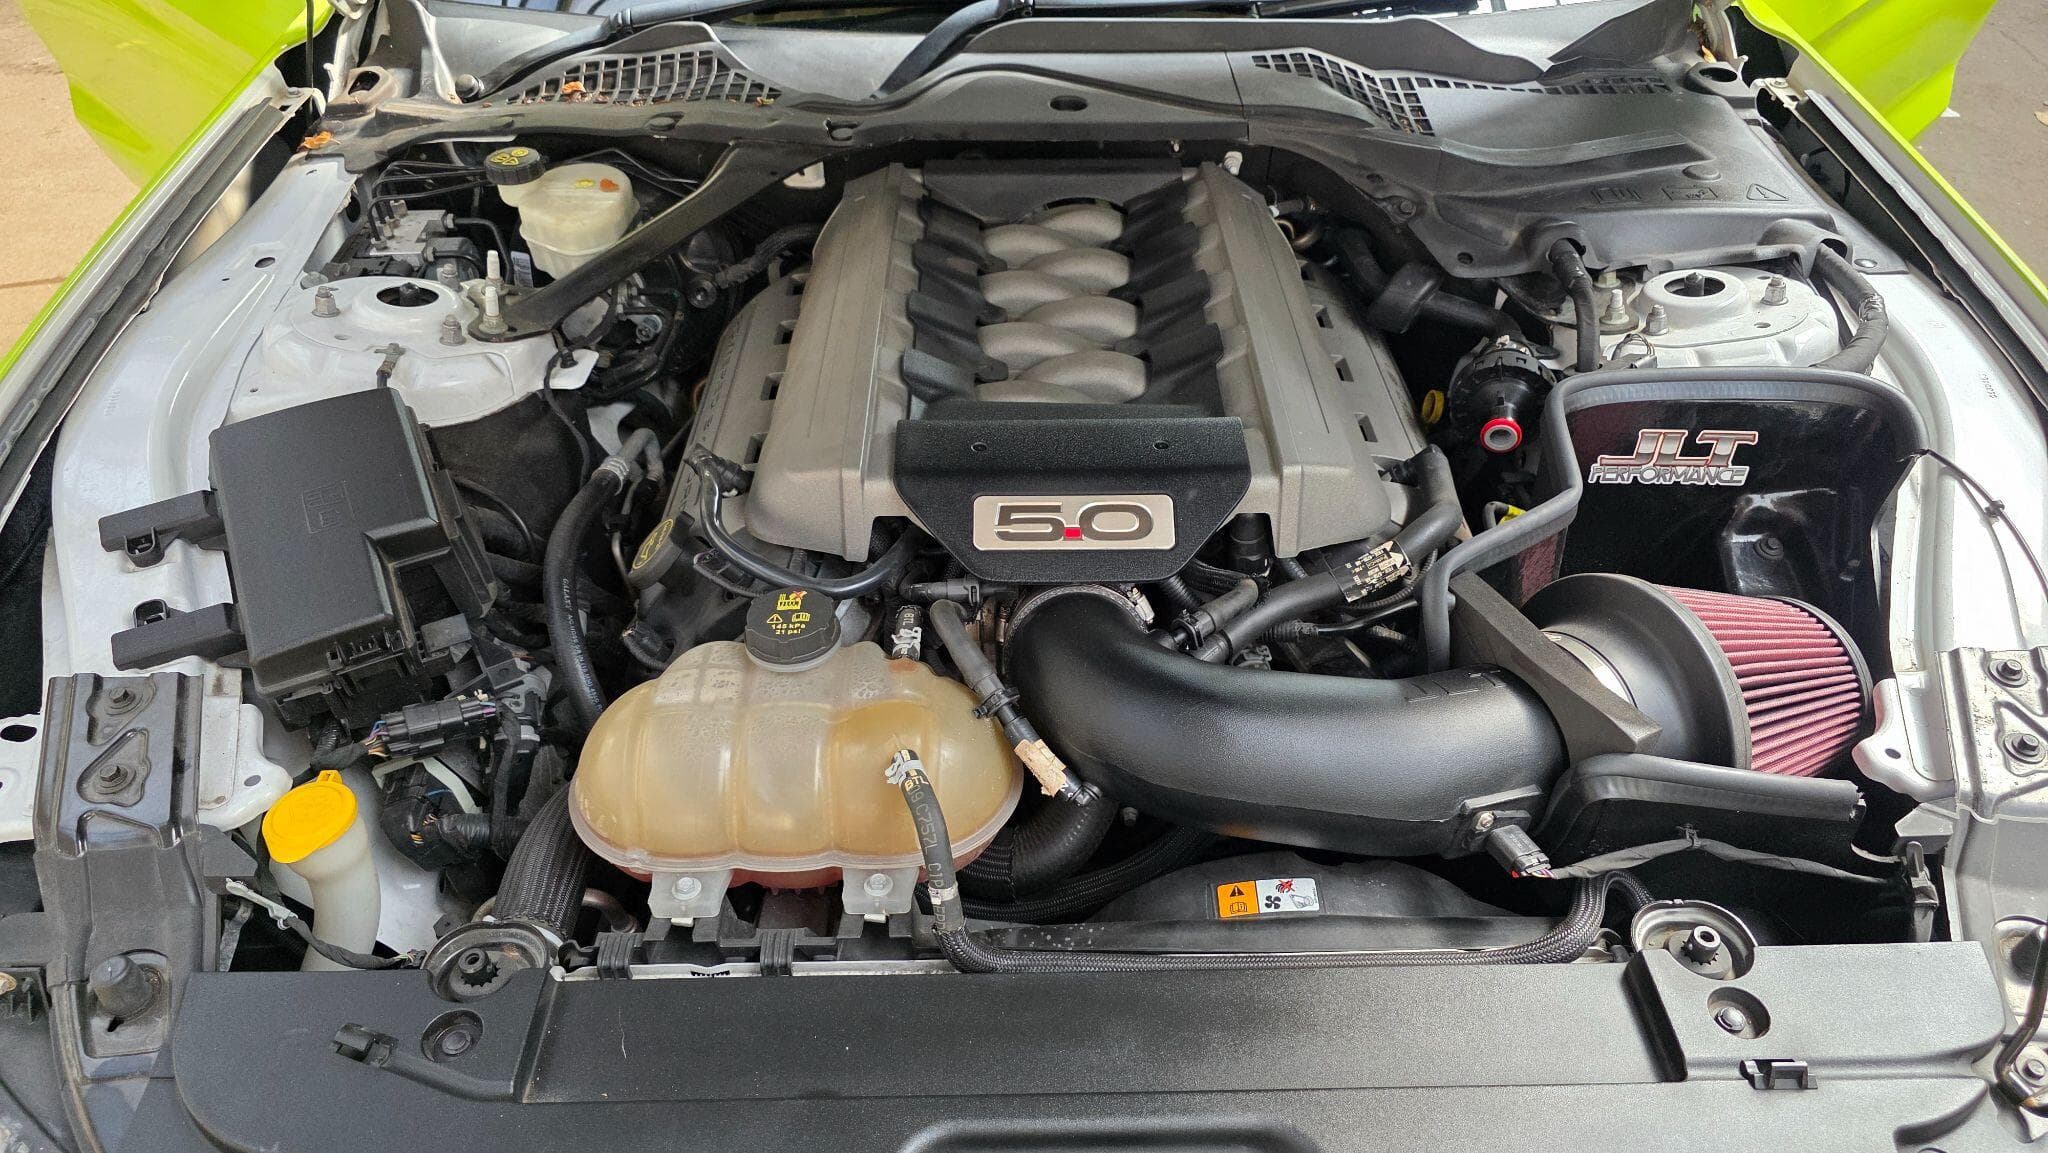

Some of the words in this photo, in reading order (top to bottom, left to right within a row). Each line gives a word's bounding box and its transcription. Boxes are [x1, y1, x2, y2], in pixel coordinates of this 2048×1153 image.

[1597, 429, 1758, 467] JLT
[1588, 464, 1750, 486] PERFORMANCE
[994, 502, 1154, 541] 5.0
[904, 775, 929, 792] BTL
